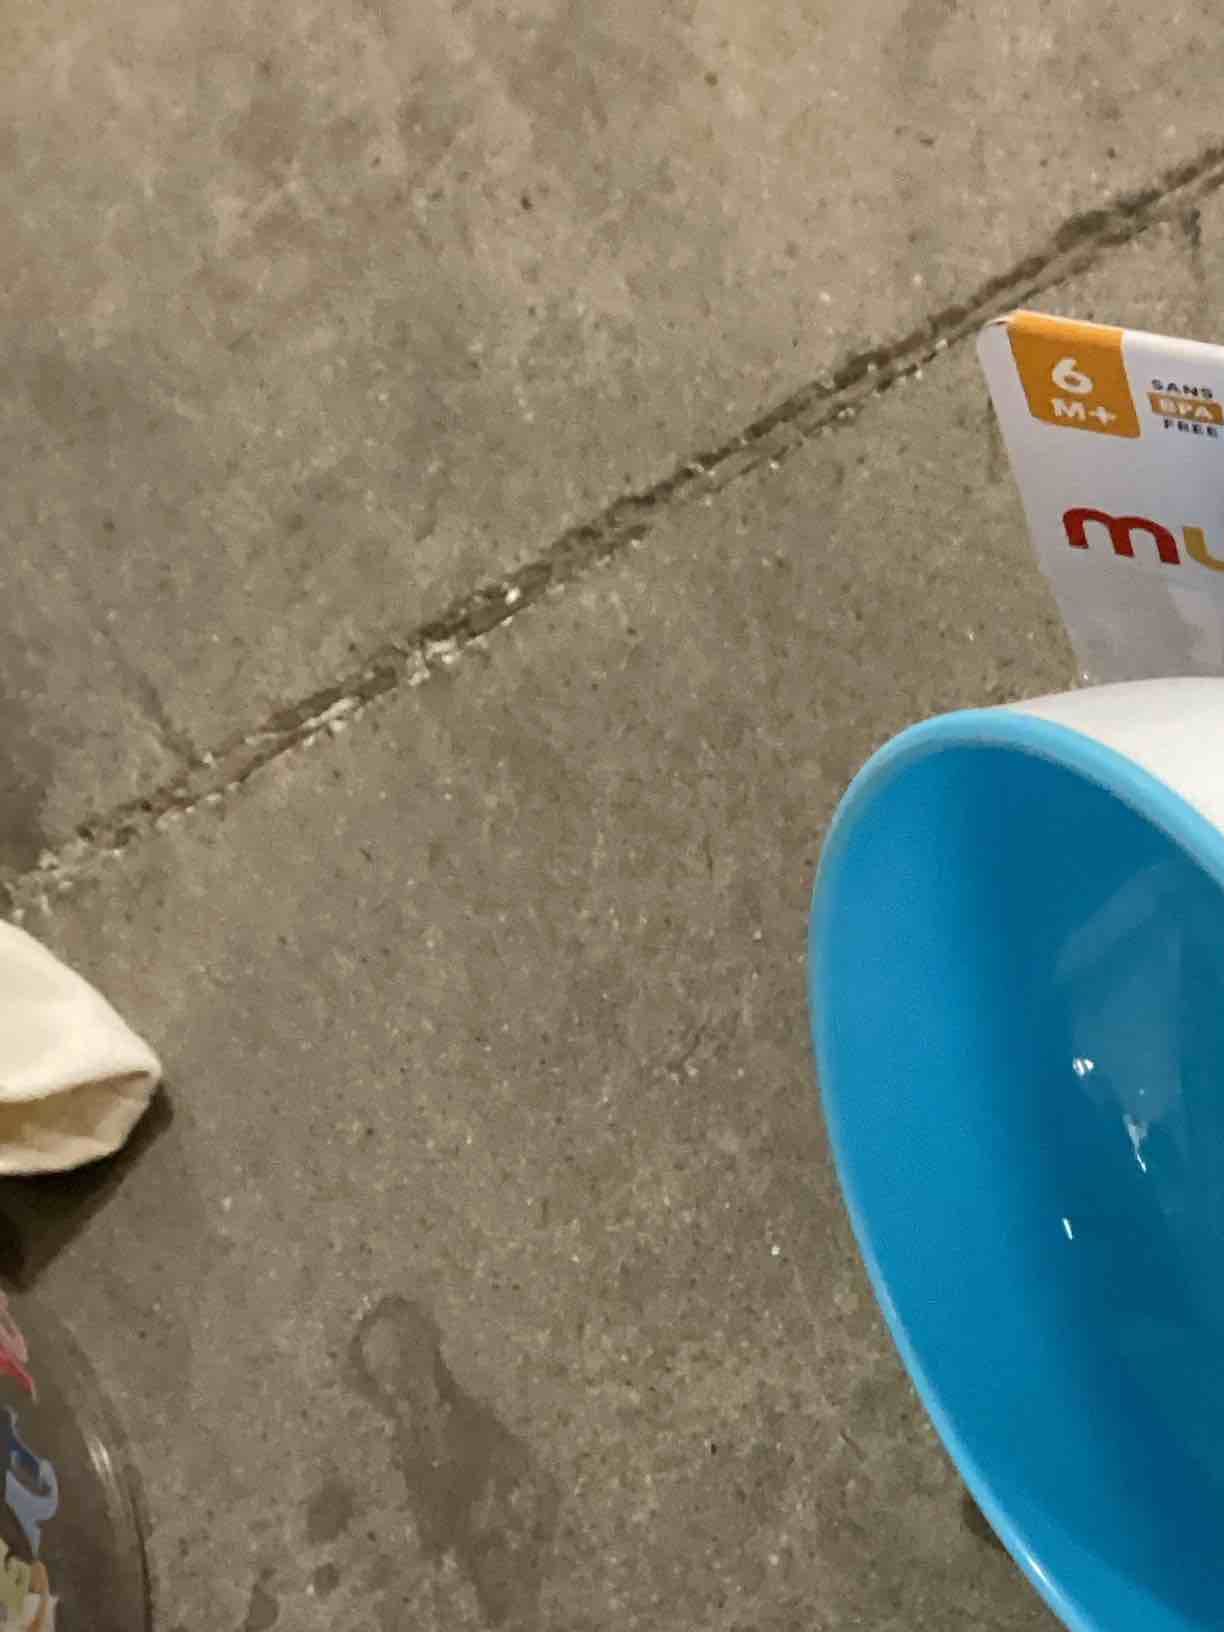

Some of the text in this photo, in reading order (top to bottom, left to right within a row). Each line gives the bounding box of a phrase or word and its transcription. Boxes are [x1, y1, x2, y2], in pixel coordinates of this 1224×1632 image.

[1050, 357, 1094, 394] 6
[1151, 378, 1213, 399] SANS
[1051, 398, 1118, 426] M+
[1163, 417, 1219, 439] FREE
